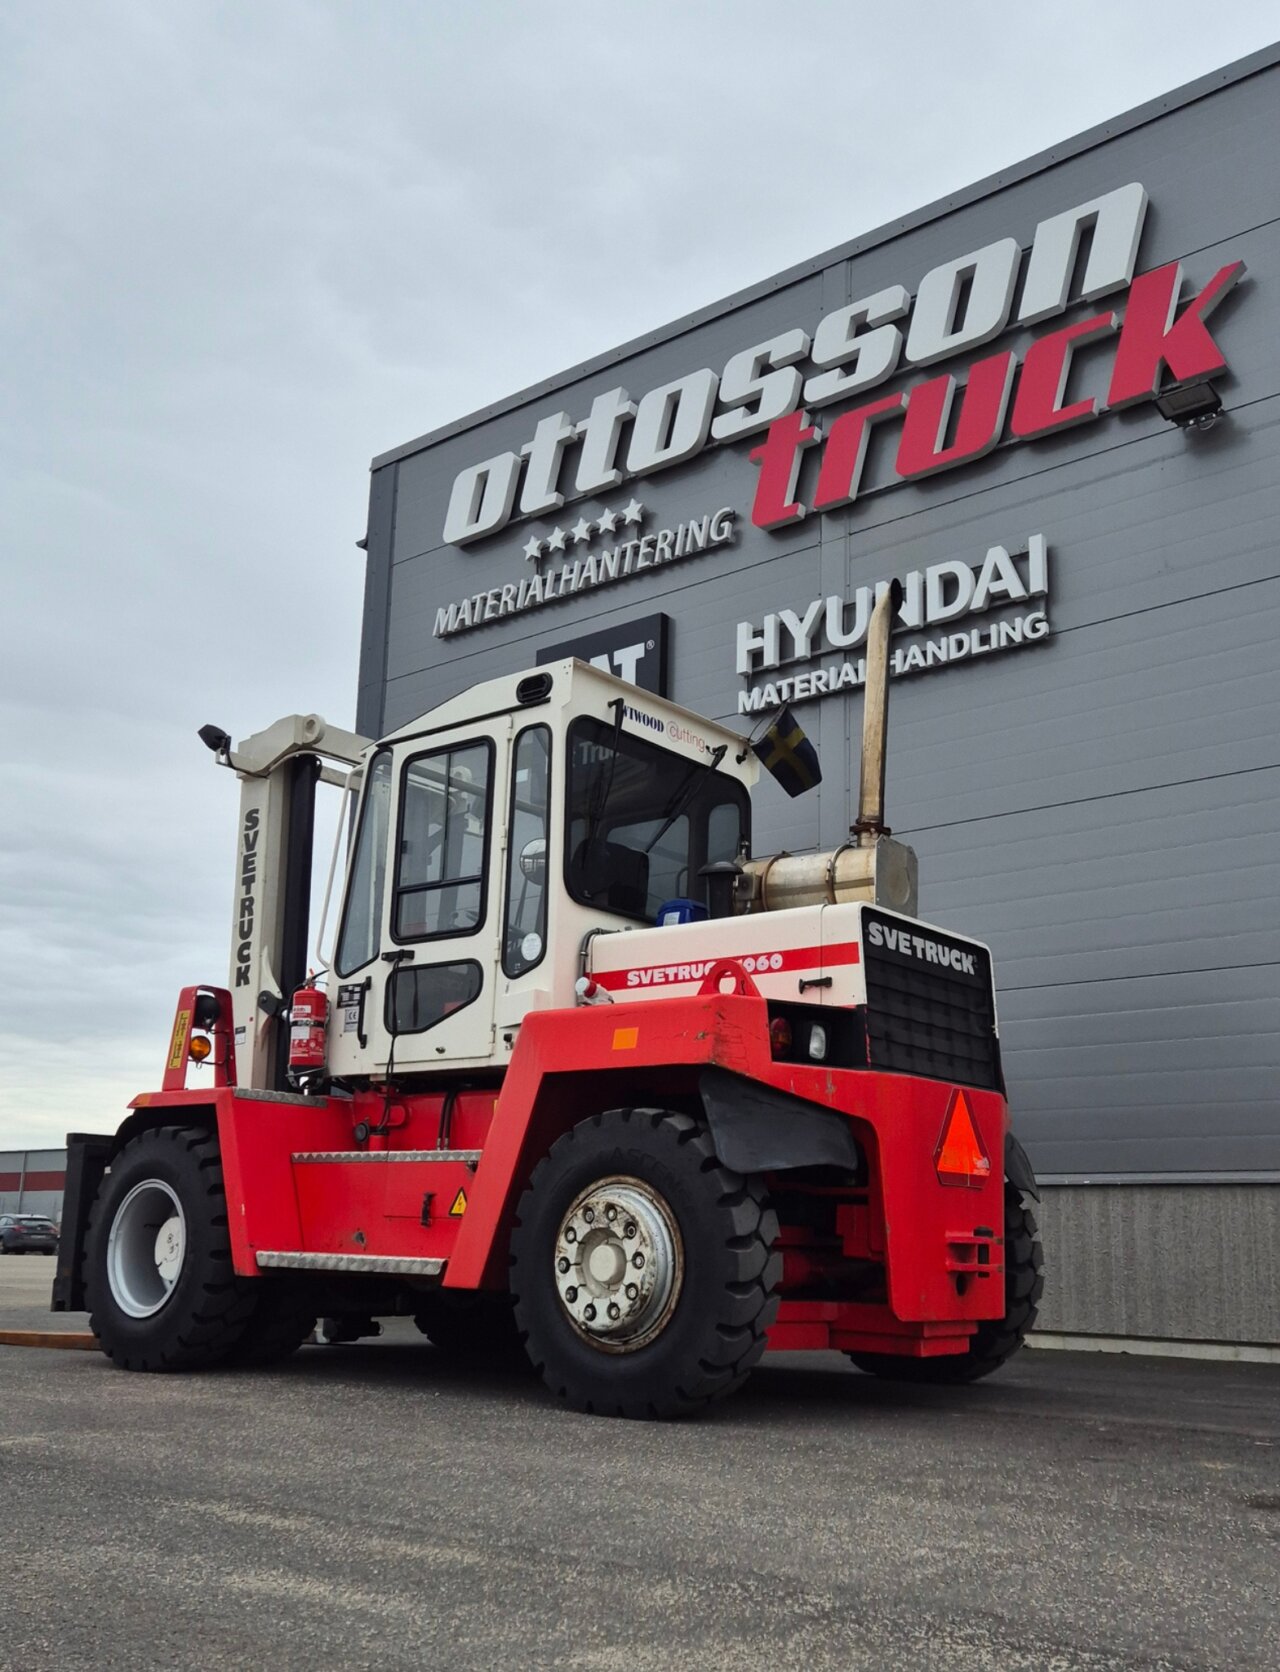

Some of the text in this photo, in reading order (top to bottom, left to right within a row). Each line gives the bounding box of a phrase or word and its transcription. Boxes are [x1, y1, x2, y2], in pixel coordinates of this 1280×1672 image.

[443, 182, 1149, 546] ottosson
[749, 260, 1247, 531] truck
[432, 506, 737, 639] MATERIALHANTERING
[736, 533, 1049, 676] HYUNDAI
[235, 807, 260, 988] SVETRUCK
[868, 921, 976, 976] SVETRUCK
